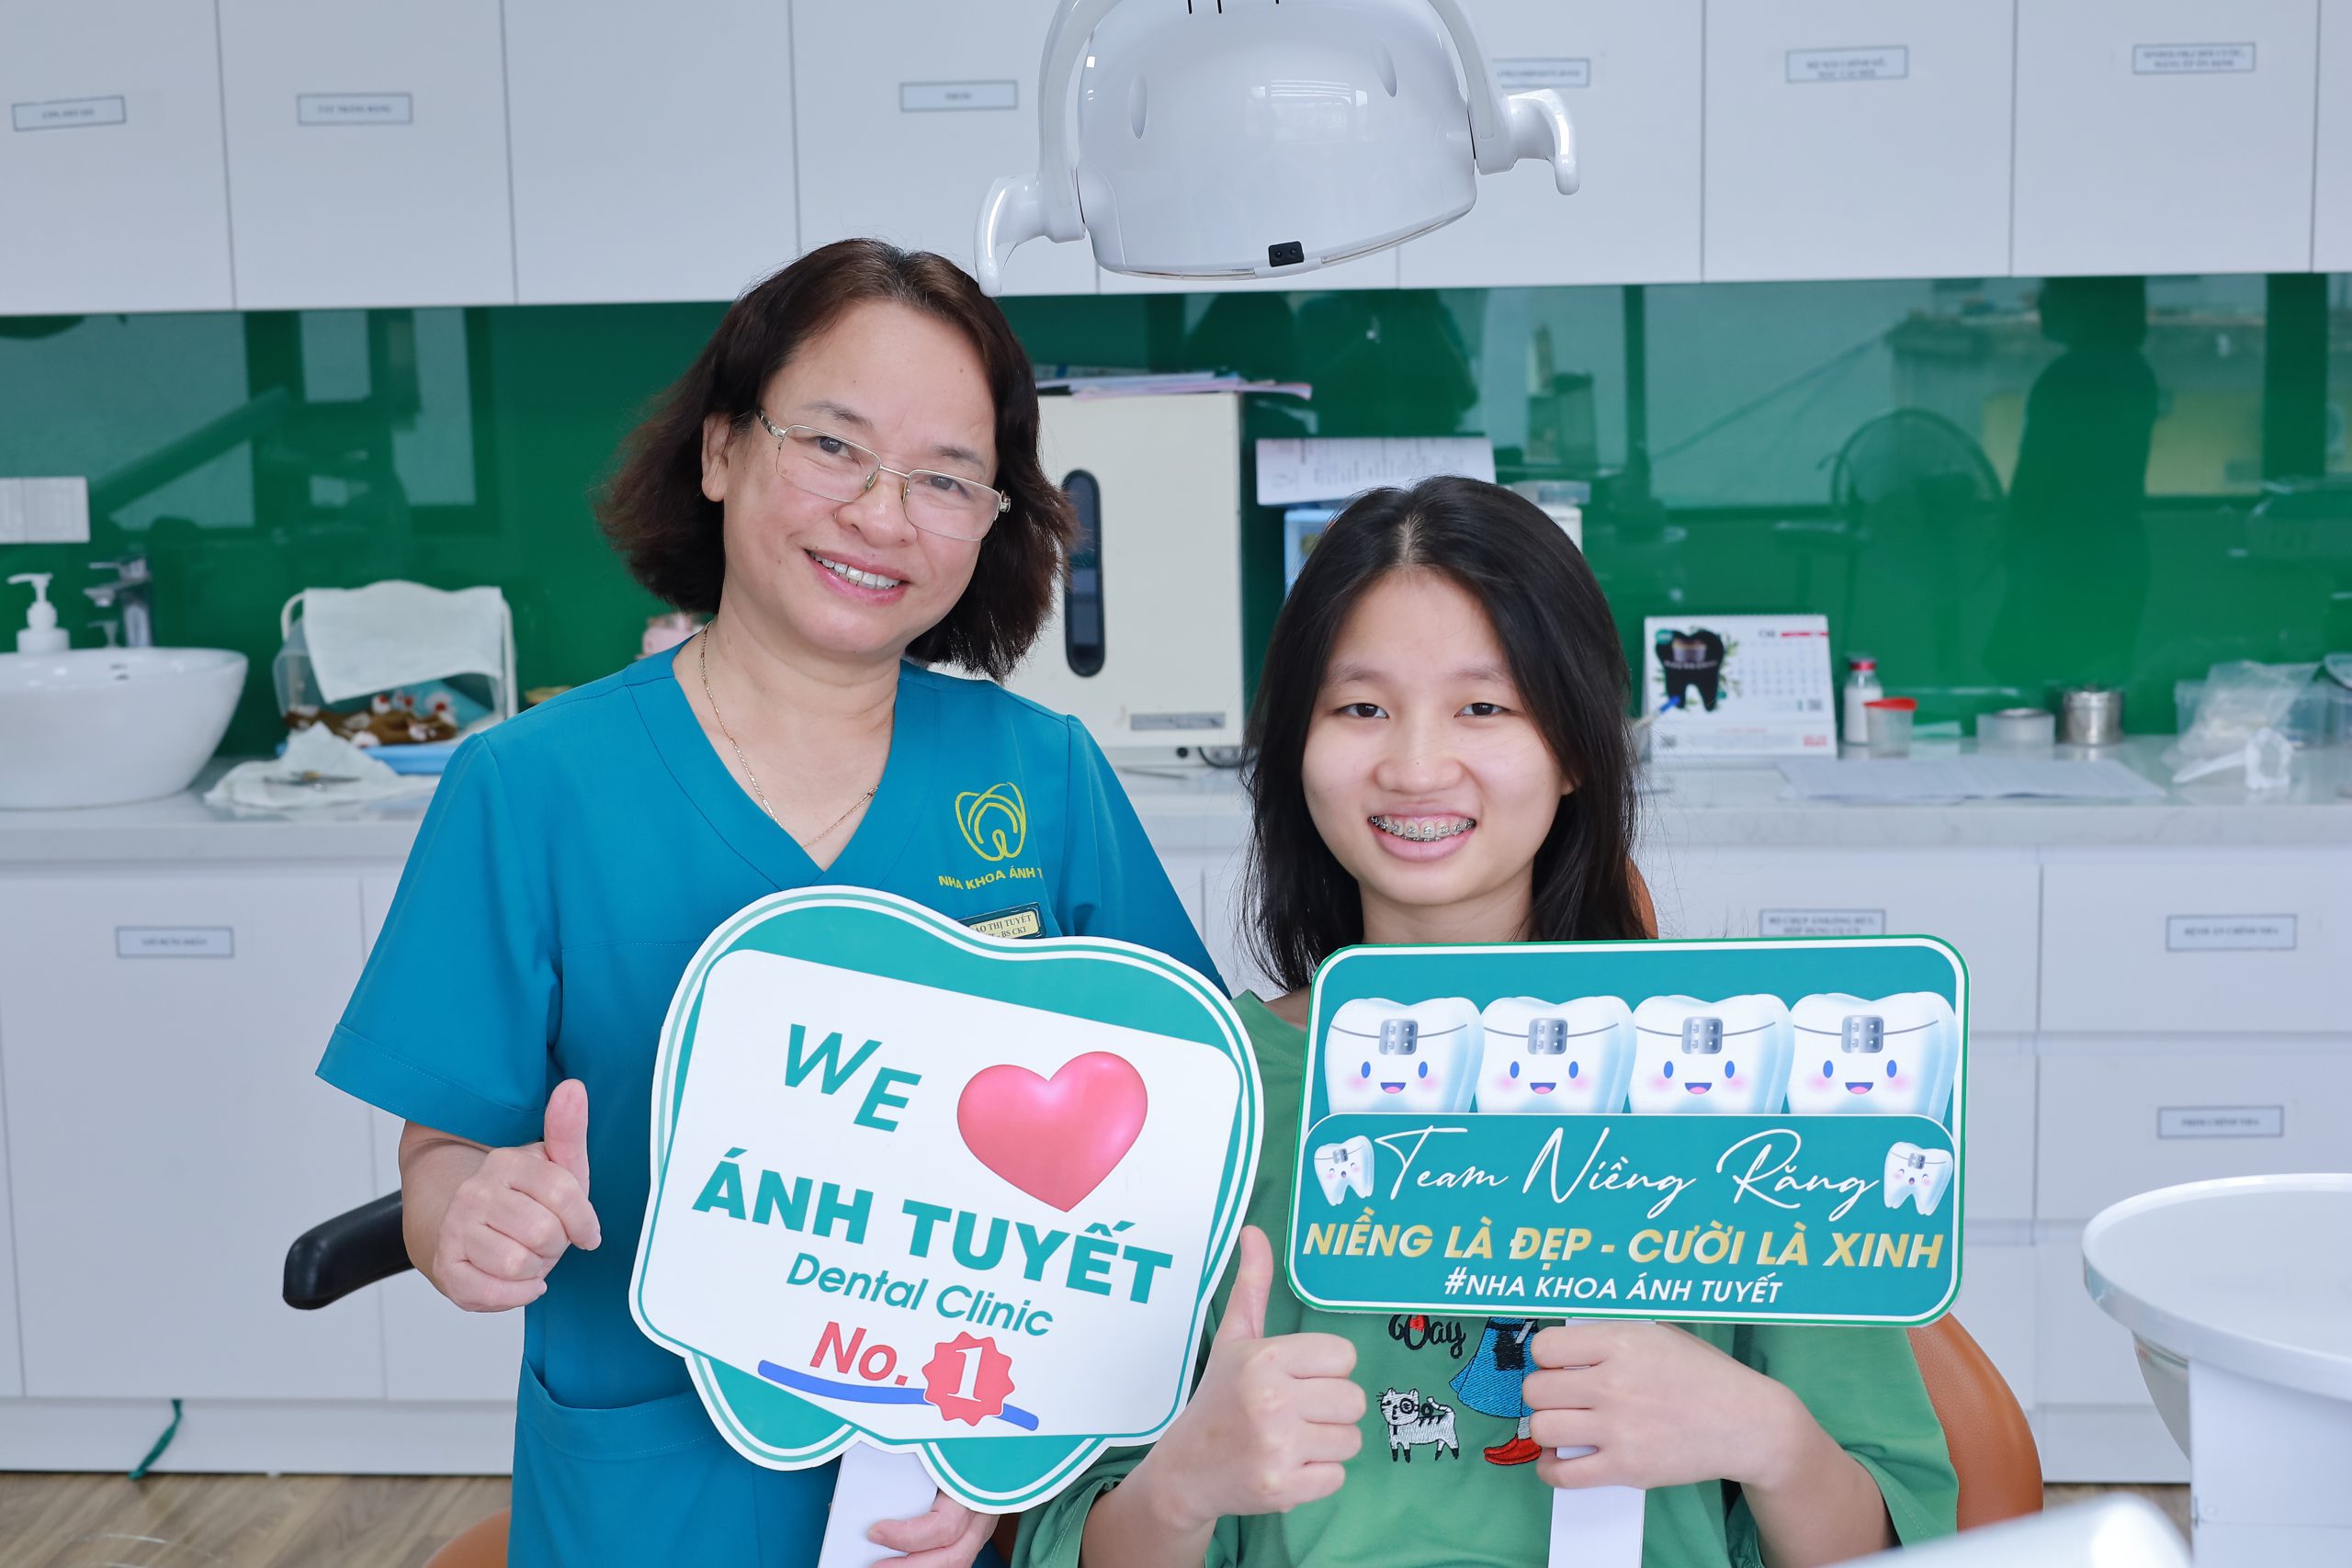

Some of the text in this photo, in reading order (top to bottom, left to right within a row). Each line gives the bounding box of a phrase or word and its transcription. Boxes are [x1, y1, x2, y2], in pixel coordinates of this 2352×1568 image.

[938, 875, 964, 890] NHA
[965, 870, 1006, 890] KHOA
[1009, 865, 1036, 879] ÁNH
[988, 921, 1004, 931] THỊ
[1001, 929, 1012, 938] BS
[784, 1022, 922, 1133] WE
[1374, 1125, 1880, 1222] Team Niềng Răng
[691, 1146, 1174, 1305] ÁNH TUYẾT
[1302, 1206, 1433, 1258] NIỀNG
[1443, 1215, 1493, 1259] LÀ
[1509, 1226, 1592, 1271] ĐẸP
[1628, 1218, 1747, 1265] CƯỜI
[1756, 1221, 1809, 1267] LÀ
[1822, 1232, 1945, 1269] XINH
[786, 1252, 1054, 1337] Dental Clinic
[1444, 1266, 1784, 1303] #NHA KHOA ÁNH TUYẾT
[809, 1321, 983, 1403] No. 1
